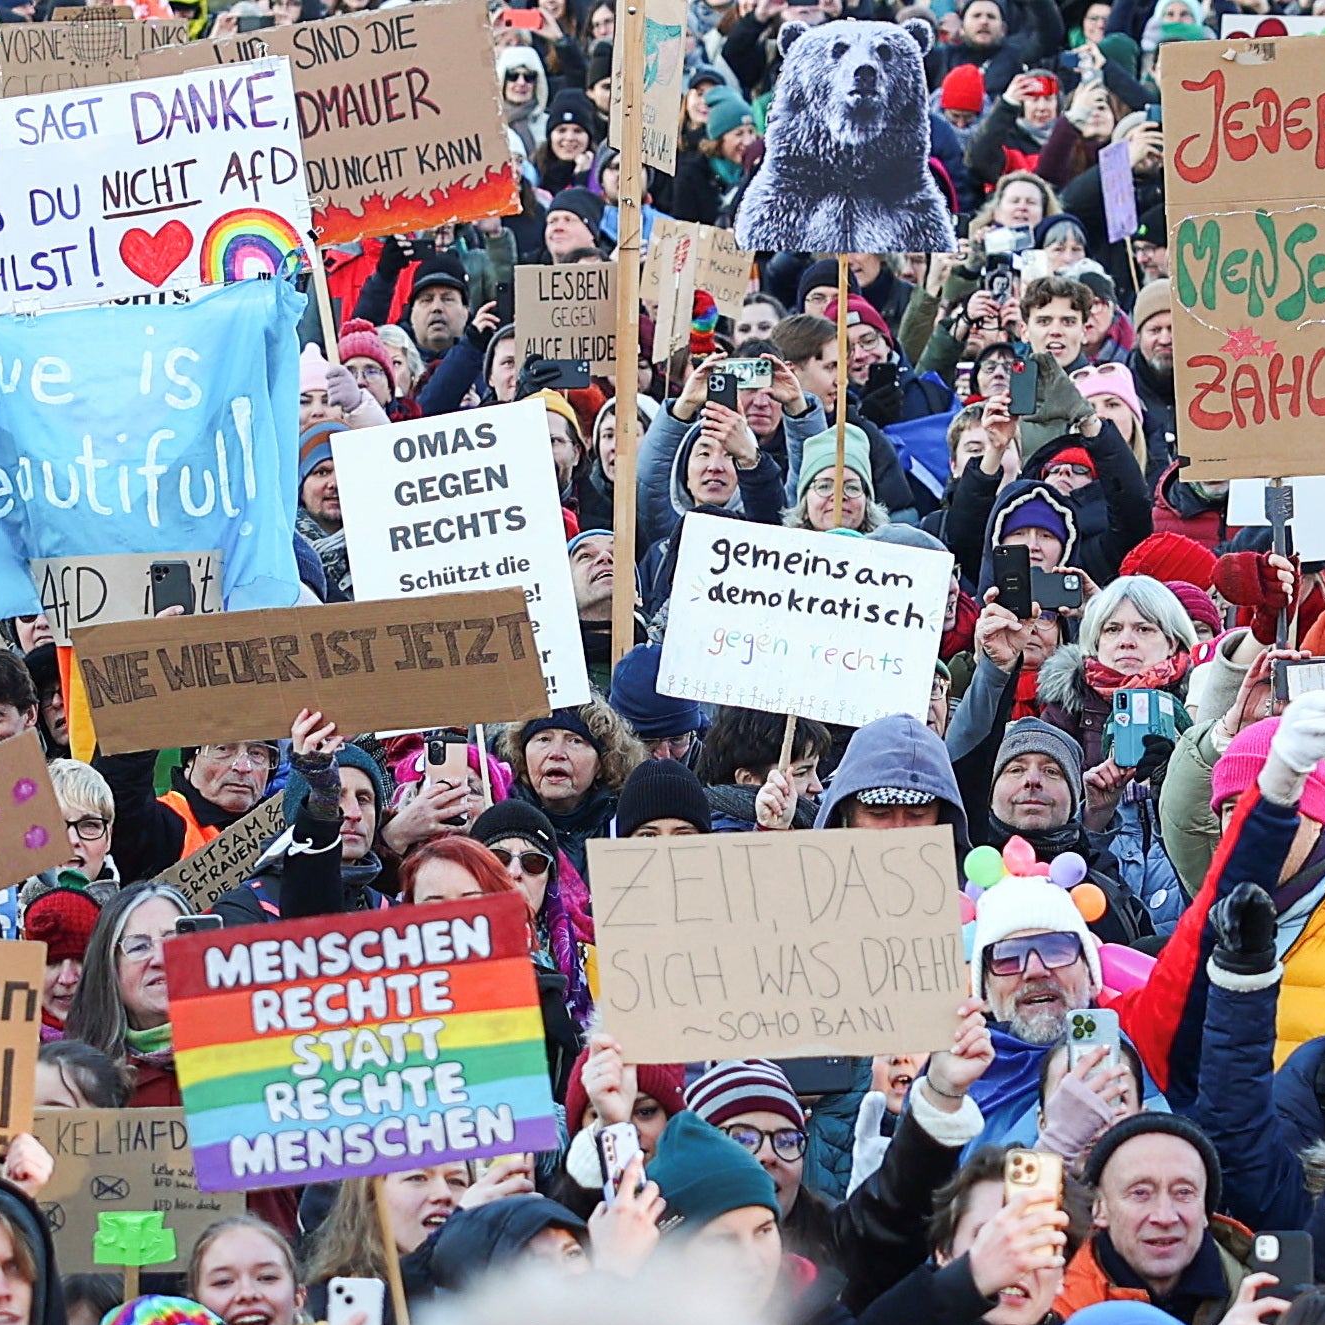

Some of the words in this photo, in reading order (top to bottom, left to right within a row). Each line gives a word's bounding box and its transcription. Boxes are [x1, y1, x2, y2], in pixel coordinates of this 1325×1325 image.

[0, 24, 65, 64] VORNE
[292, 23, 361, 71] SIND
[365, 13, 419, 55] DIE
[14, 97, 104, 146] SAGT
[130, 70, 290, 146] DANKE,
[415, 133, 484, 176] KANN
[29, 184, 82, 227] DU
[101, 158, 198, 212] NICHT
[219, 146, 299, 203] AfD
[537, 269, 609, 303] LESBEN
[551, 305, 597, 328] GEGEN
[140, 325, 203, 412] is
[392, 422, 498, 464] OMAS
[393, 463, 509, 507] GEGEN
[388, 505, 527, 552] RECHTS
[38, 563, 109, 630] AfD
[399, 560, 491, 593] Schützt
[494, 555, 531, 576] die
[707, 581, 925, 630] demokratisch
[80, 650, 159, 709] NIE
[158, 635, 308, 692] WIEDER
[309, 627, 379, 680] IST
[387, 611, 532, 672] JETZT
[707, 627, 789, 665] gegen
[809, 641, 905, 676] rechts
[797, 842, 948, 924] DASS
[204, 914, 492, 989] MENSCHEN
[609, 945, 728, 1012] SICH
[752, 940, 842, 1000] WAS
[860, 932, 961, 997] DREHT
[251, 969, 455, 1034] RECHTE
[810, 1005, 896, 1037] BANI
[290, 1017, 446, 1077] STATT
[263, 1061, 470, 1123] RECHTE
[229, 1103, 516, 1178] MENSCHEN
